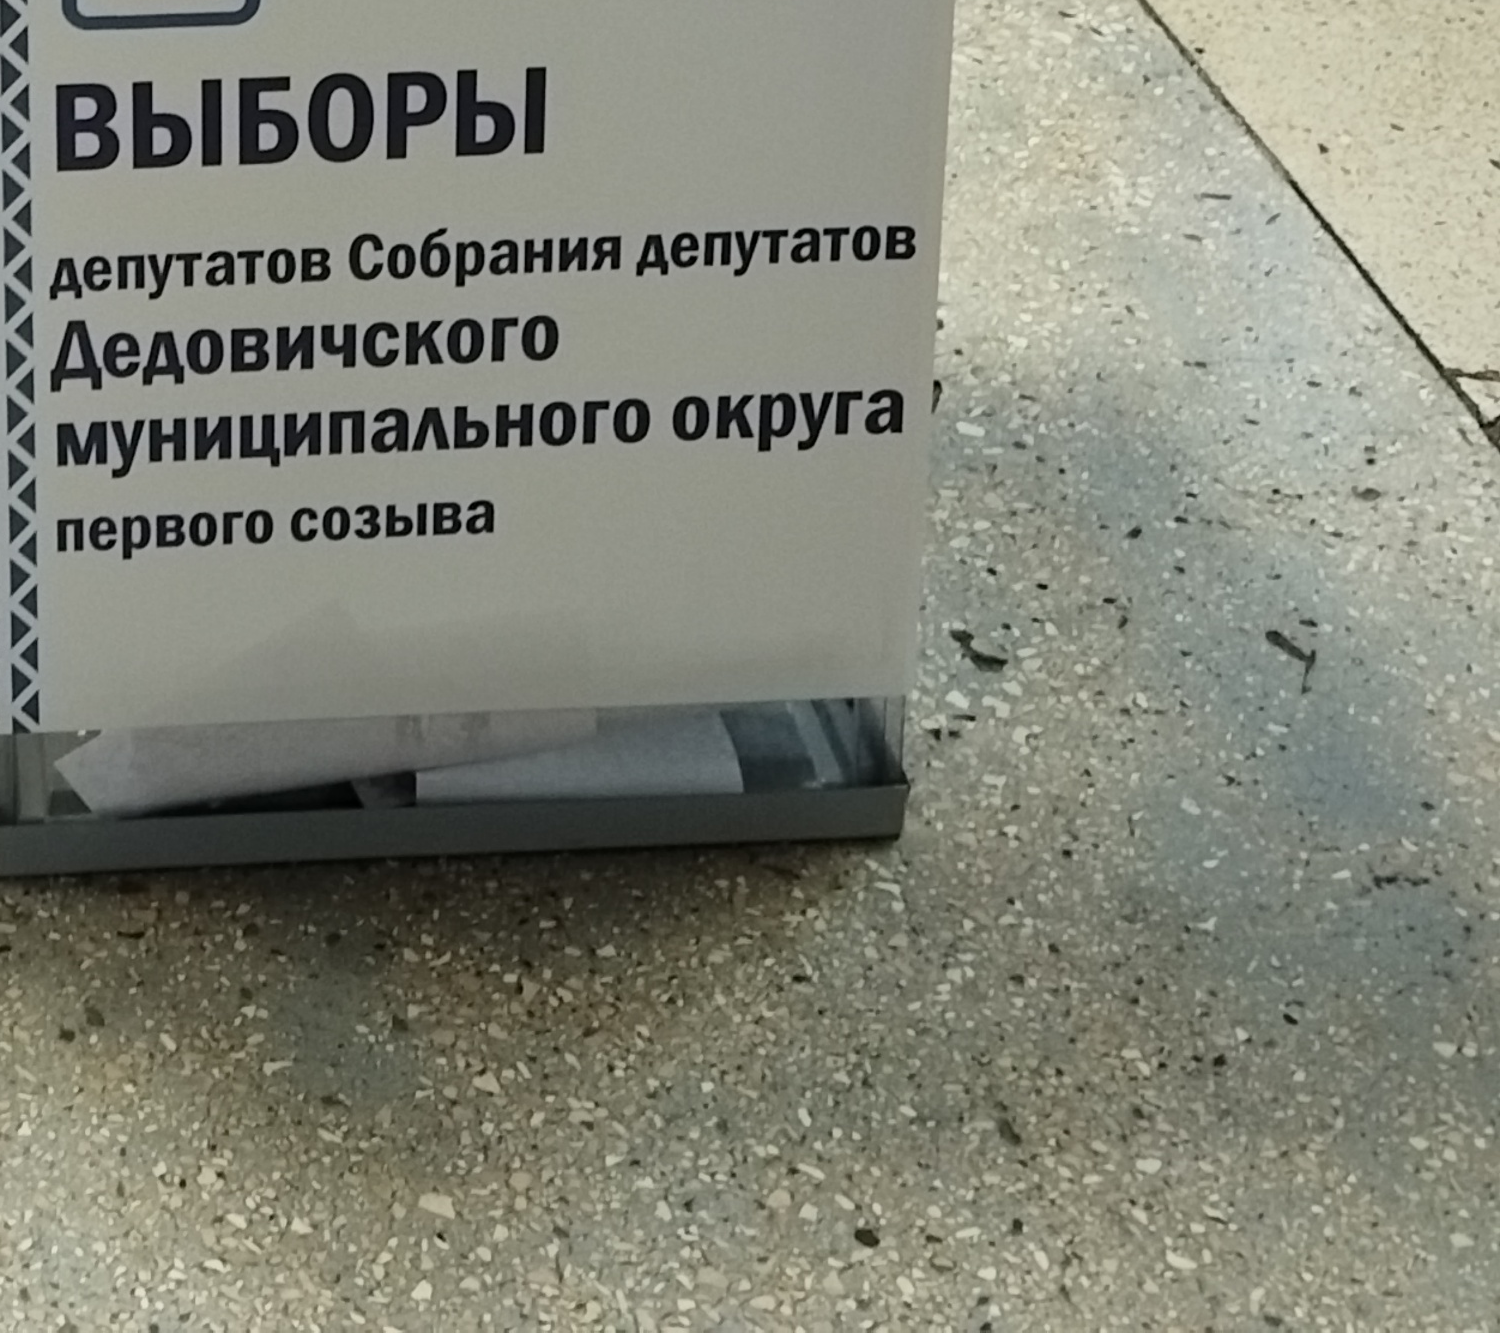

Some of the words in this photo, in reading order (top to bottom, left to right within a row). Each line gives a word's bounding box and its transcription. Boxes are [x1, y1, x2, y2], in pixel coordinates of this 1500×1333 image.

[55, 66, 547, 172] ВЫБОРЫ
[49, 247, 332, 301] депутатов
[348, 227, 622, 288] Собрания
[635, 225, 916, 277] депутатов
[50, 315, 559, 393] Дедовичского
[56, 398, 651, 479] муниципального
[672, 388, 904, 453] округа
[56, 509, 274, 561] первого
[290, 499, 495, 543] созыва
